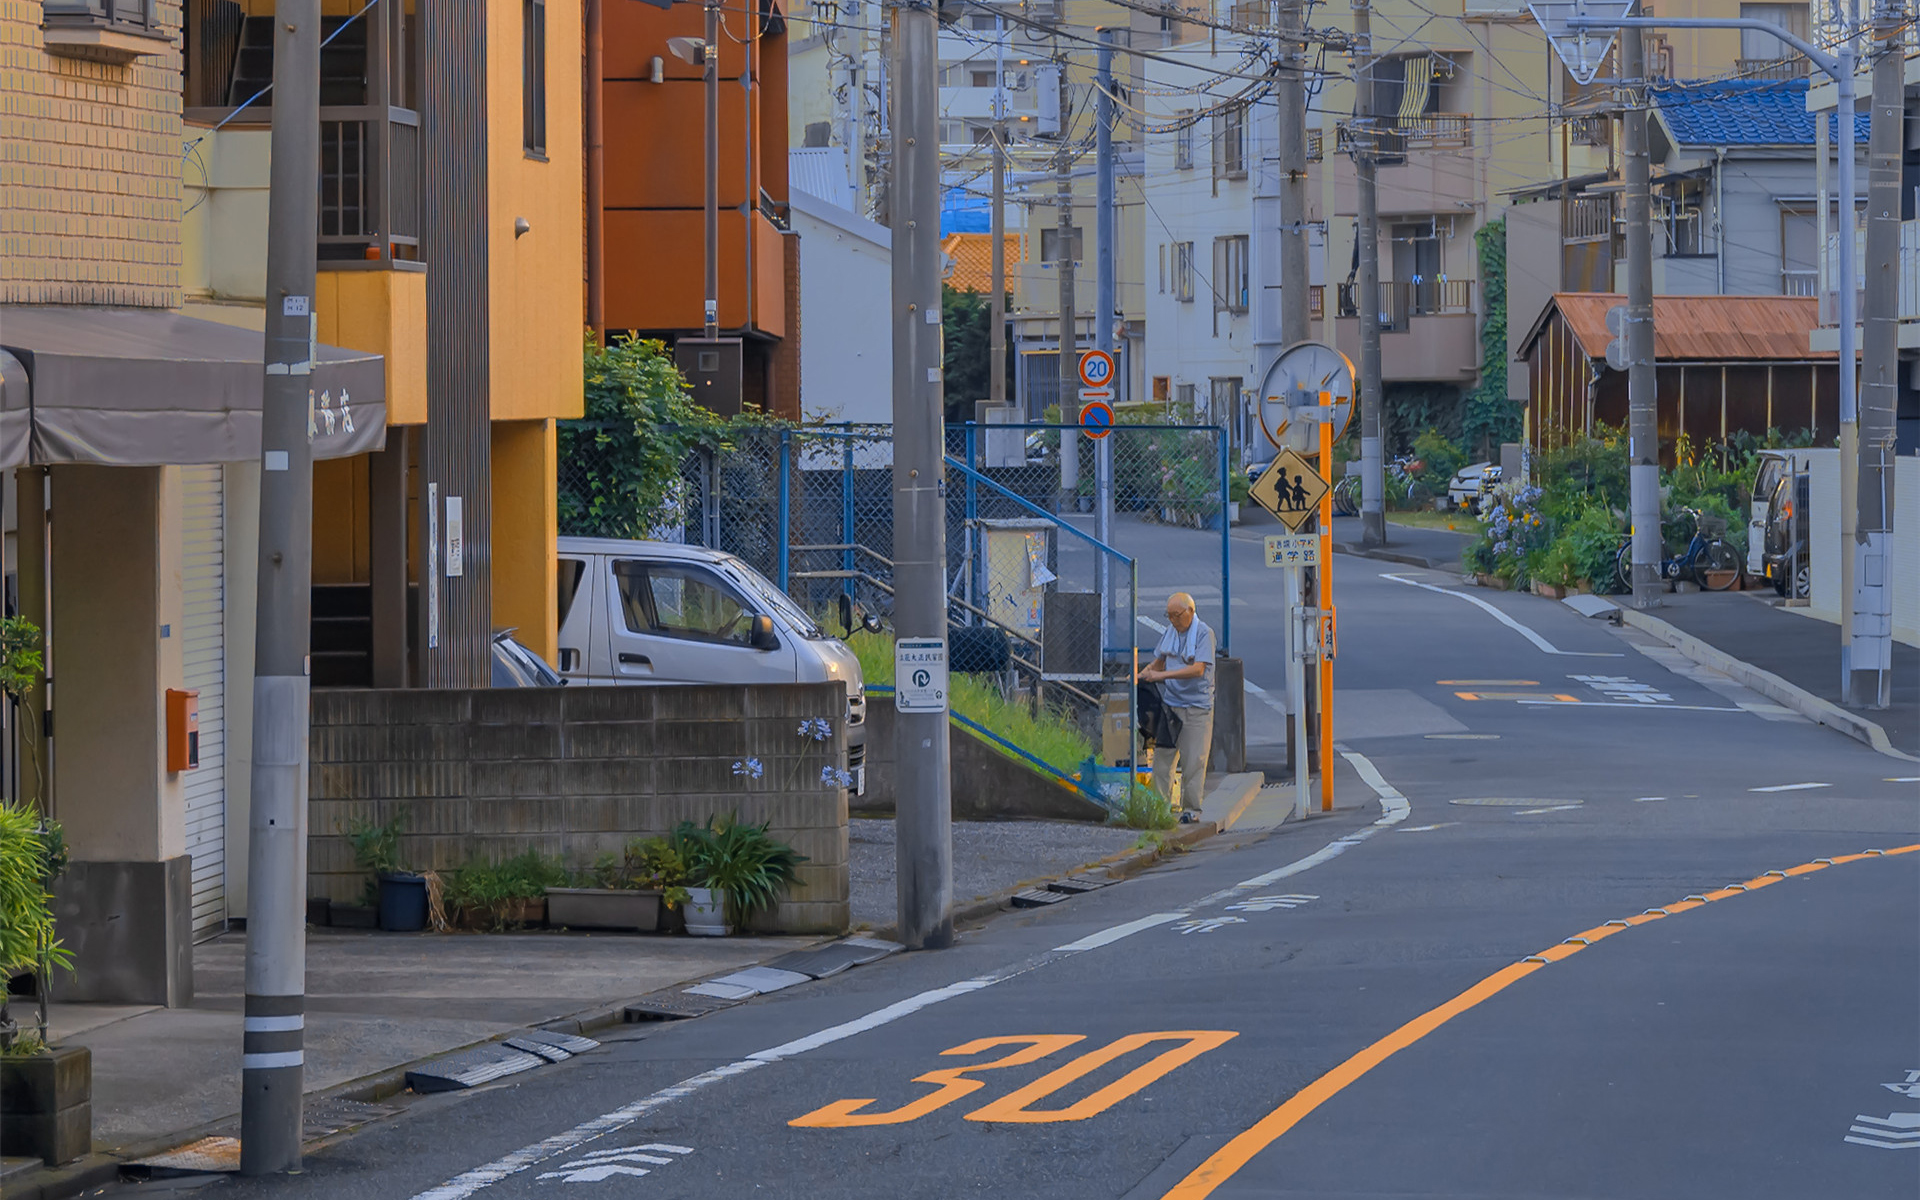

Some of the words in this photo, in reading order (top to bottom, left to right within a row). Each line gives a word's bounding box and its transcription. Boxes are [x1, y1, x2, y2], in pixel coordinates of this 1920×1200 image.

[1087, 361, 1107, 378] 20
[1271, 550, 1316, 563] 通学路
[787, 1030, 1240, 1128] 30
